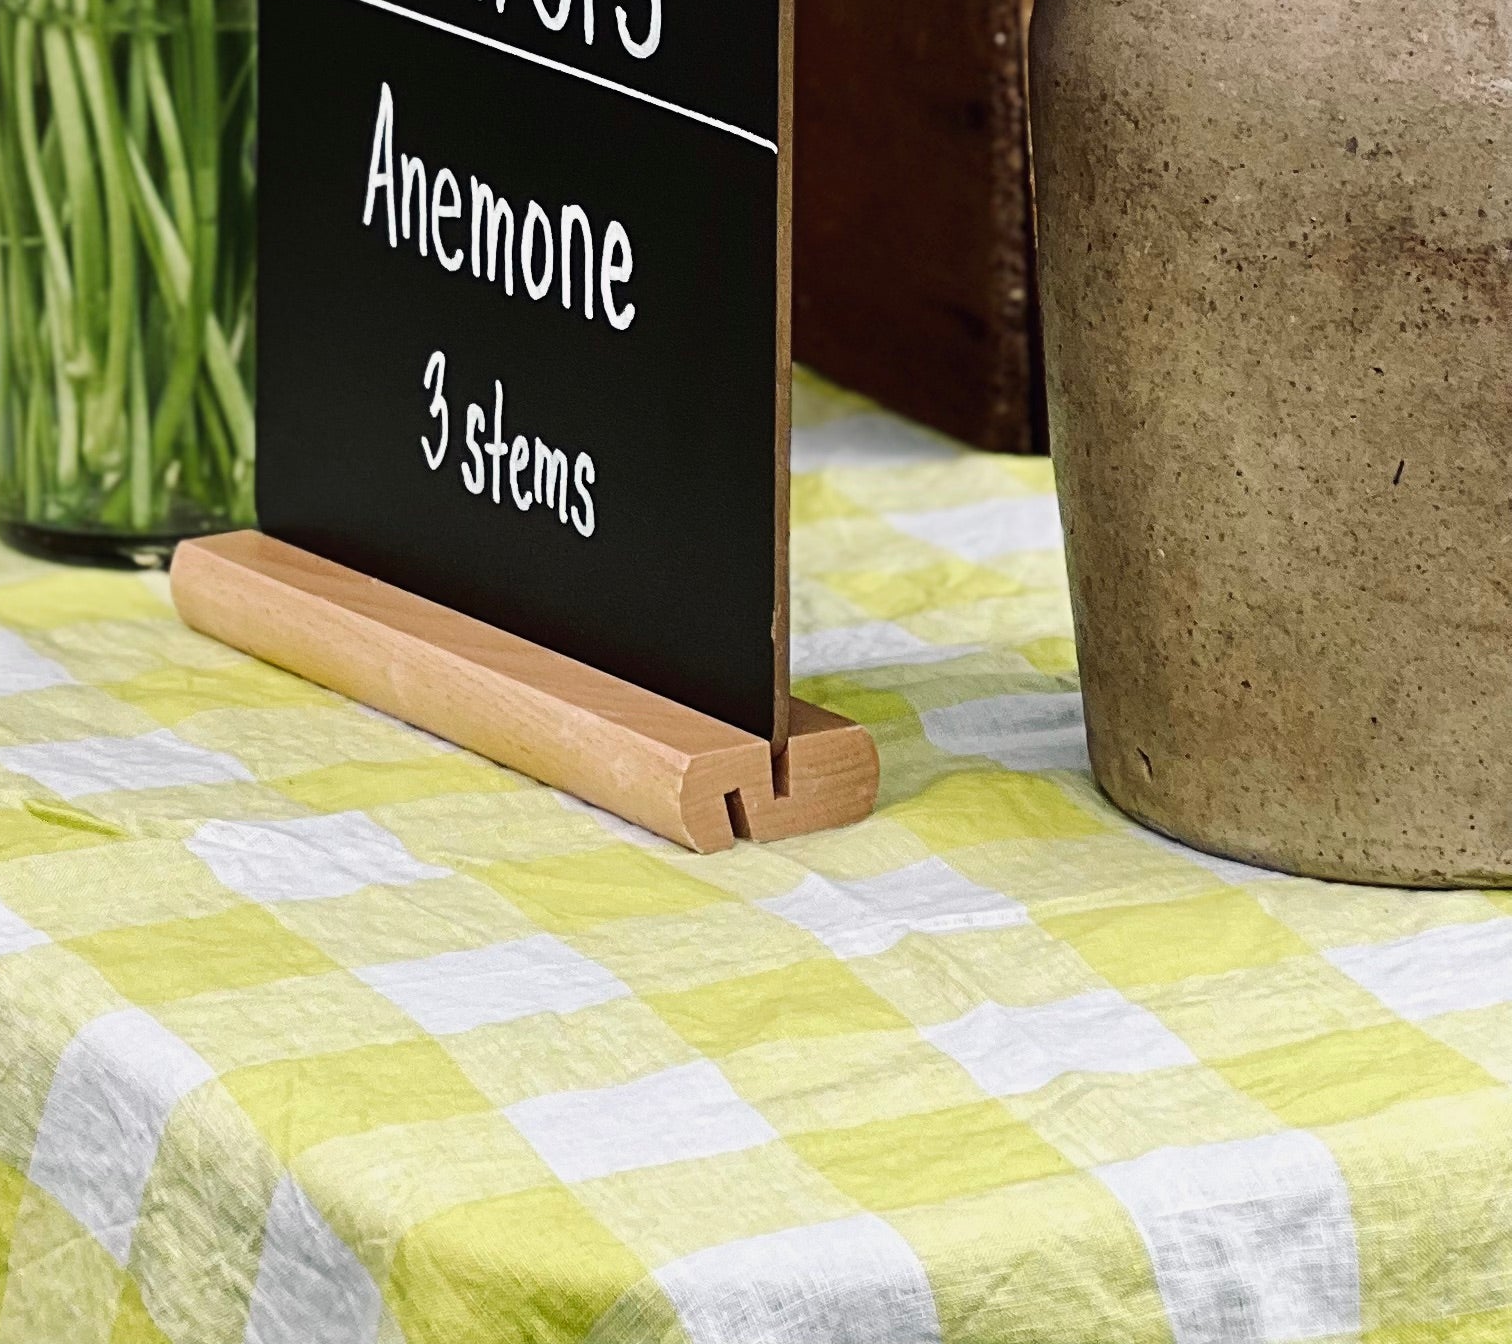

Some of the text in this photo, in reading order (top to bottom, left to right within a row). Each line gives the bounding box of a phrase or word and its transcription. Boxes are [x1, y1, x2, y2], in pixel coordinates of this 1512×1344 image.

[362, 81, 636, 331] Anemone
[420, 350, 596, 538] 3 stems
